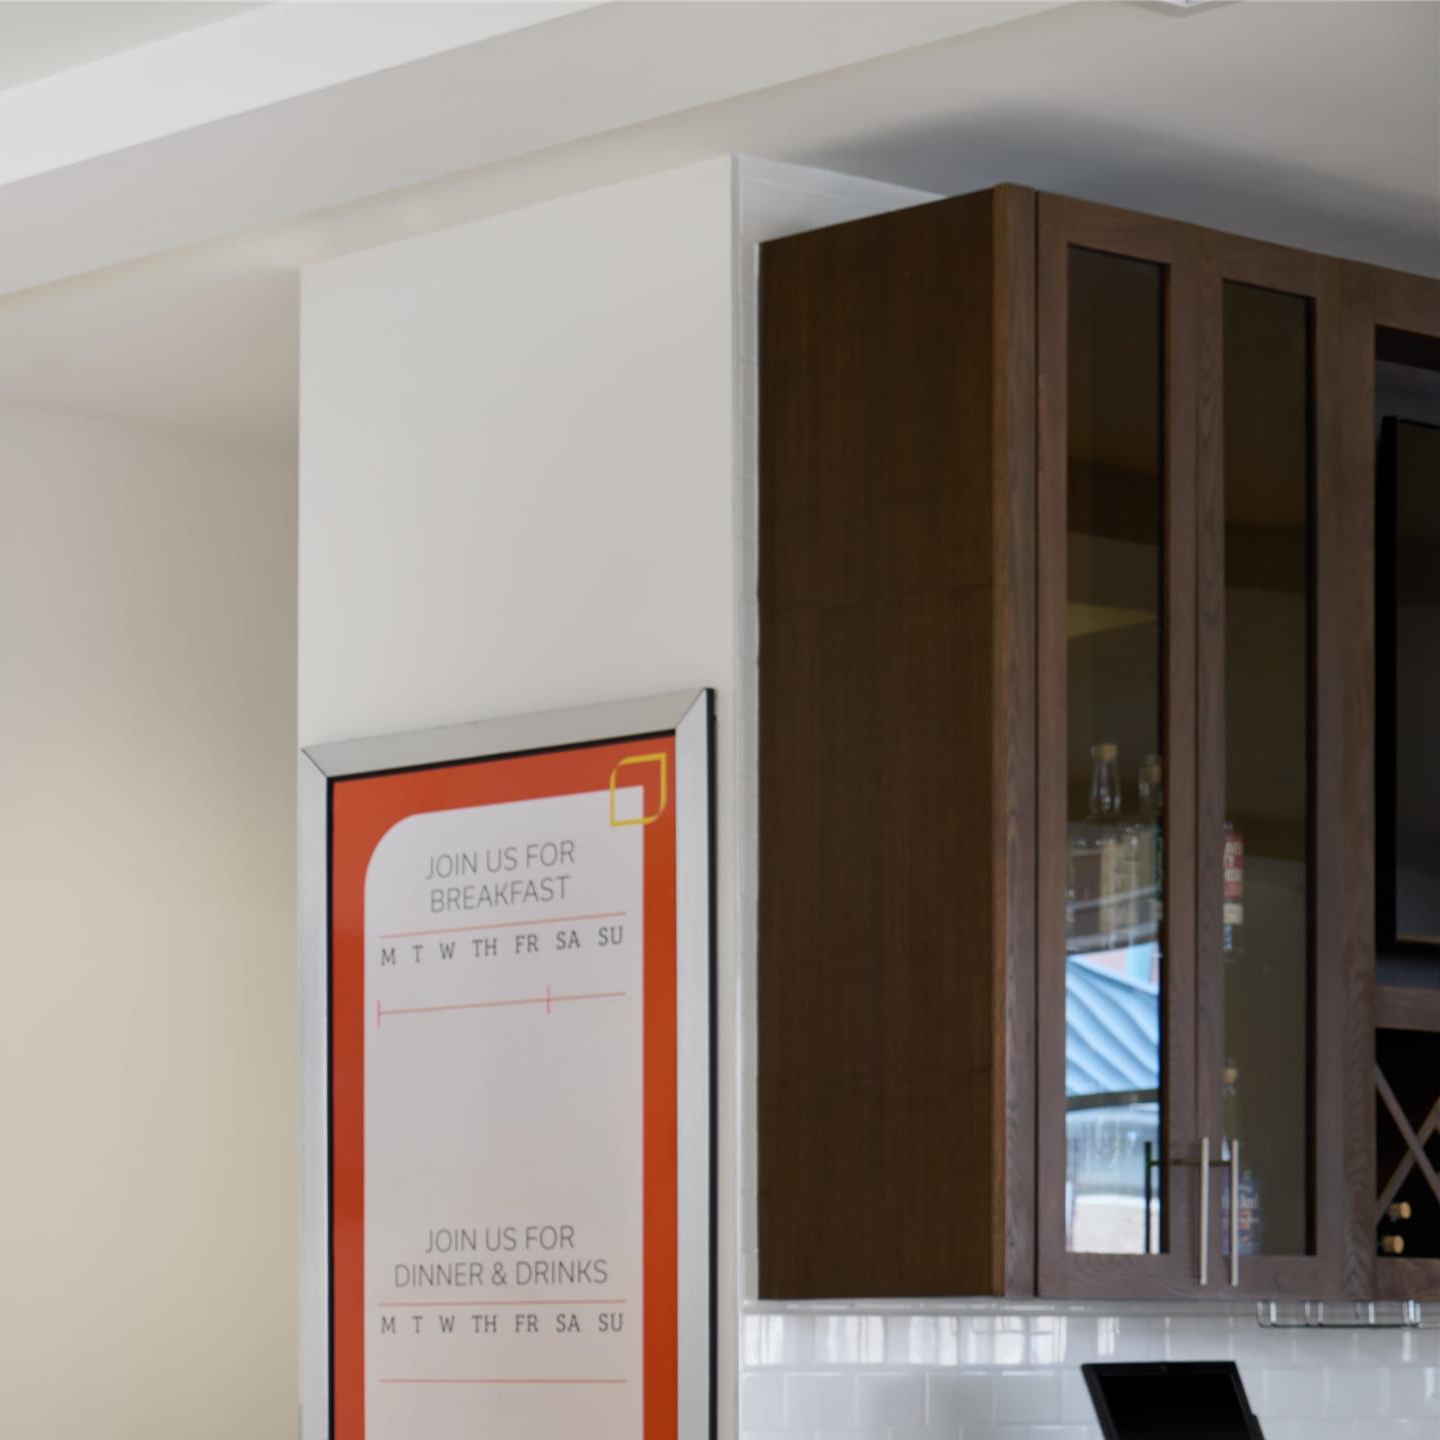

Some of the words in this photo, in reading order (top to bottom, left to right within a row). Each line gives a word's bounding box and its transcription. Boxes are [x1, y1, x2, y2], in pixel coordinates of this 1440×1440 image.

[425, 852, 478, 881] JOIN
[485, 846, 518, 873] US
[525, 839, 576, 868] FOR
[430, 874, 572, 914] BREAKFAST
[381, 948, 396, 967] M
[412, 945, 423, 963] T
[439, 941, 456, 960] W
[472, 937, 498, 958] TH
[514, 933, 539, 955] FR
[555, 929, 581, 951] SA
[598, 925, 624, 947] SU
[425, 1228, 477, 1254] JOIN
[485, 1226, 517, 1252] US
[525, 1224, 575, 1251] FOR
[394, 1262, 483, 1288] DINNER
[491, 1261, 508, 1286] &
[515, 1258, 608, 1285] DRINKS
[381, 1316, 396, 1334] M
[411, 1316, 423, 1333] T
[439, 1315, 455, 1333] W
[471, 1314, 498, 1333] TH
[514, 1314, 539, 1333] FR
[555, 1313, 581, 1333] SA
[597, 1313, 624, 1332] SU
